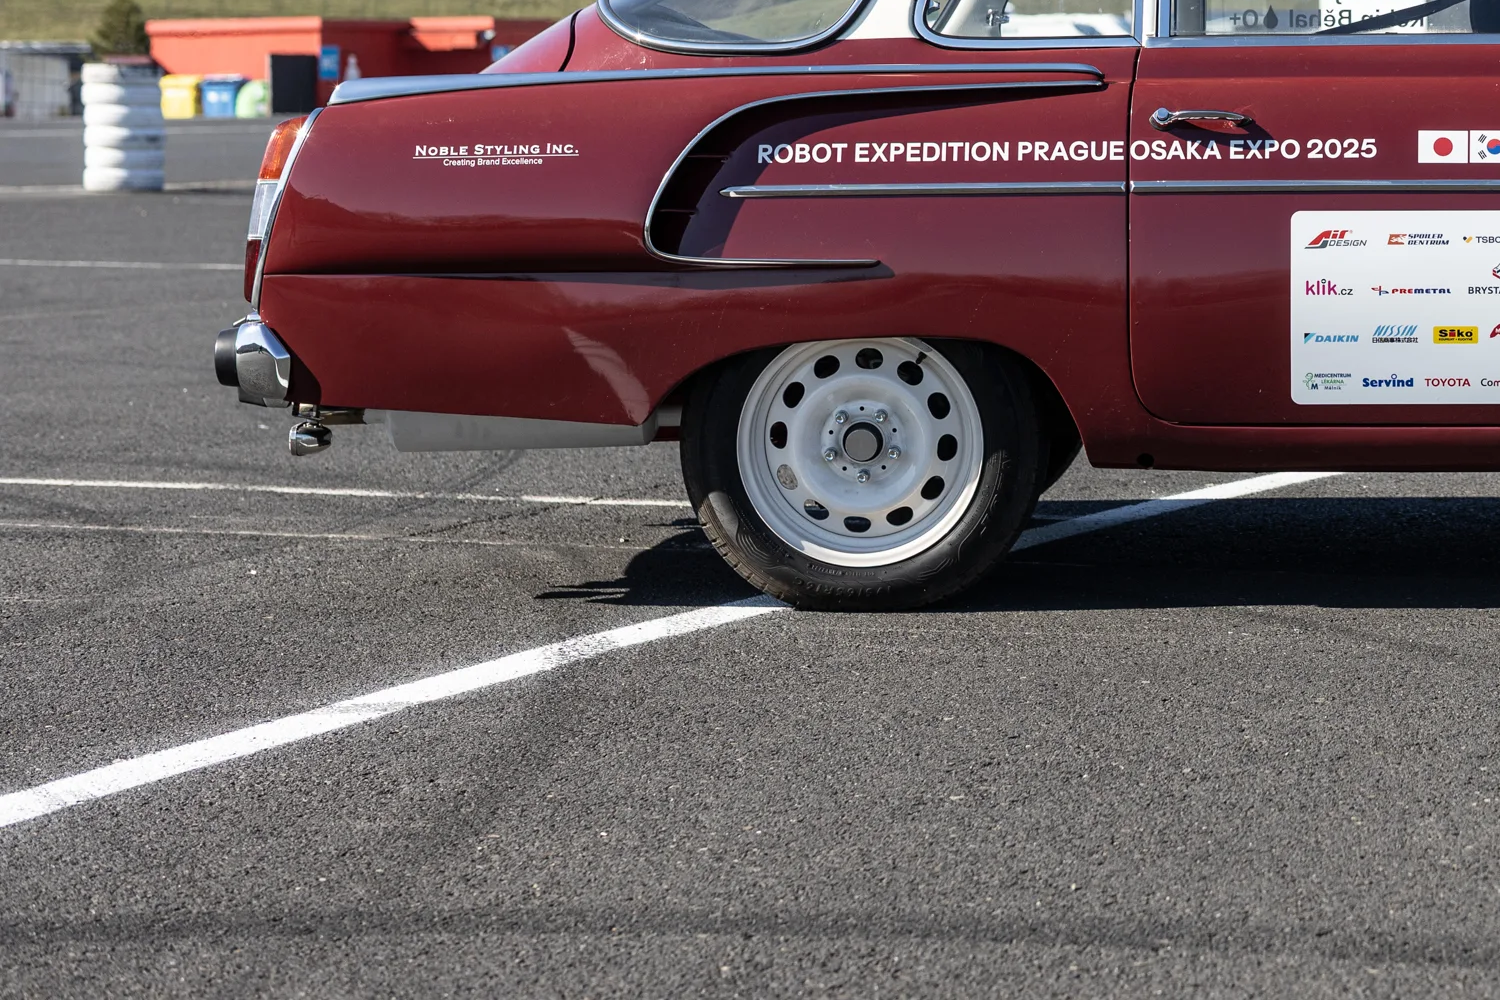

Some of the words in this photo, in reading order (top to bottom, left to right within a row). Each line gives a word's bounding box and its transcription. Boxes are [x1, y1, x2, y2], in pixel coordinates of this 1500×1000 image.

[415, 145, 468, 156] NOBLE
[474, 144, 540, 155] STYLING
[758, 141, 848, 163] ROBOT
[854, 140, 1006, 163] EXPEDITION
[1017, 140, 1125, 162] PRAGUE
[1130, 139, 1222, 161] OSAKA
[1229, 139, 1301, 160] EXPO
[1307, 138, 1378, 159] 2025
[443, 158, 476, 167] Creating
[477, 158, 500, 166] Brand
[502, 157, 543, 165] Excellence
[1328, 239, 1368, 247] DESIGN
[1305, 278, 1354, 296] klik.cz
[1391, 287, 1451, 295] PREMETAL
[1373, 325, 1419, 337] NISSIN
[1315, 334, 1360, 343] DAIKIN
[1362, 374, 1414, 388] Servind
[1424, 378, 1471, 387] TOYOTA
